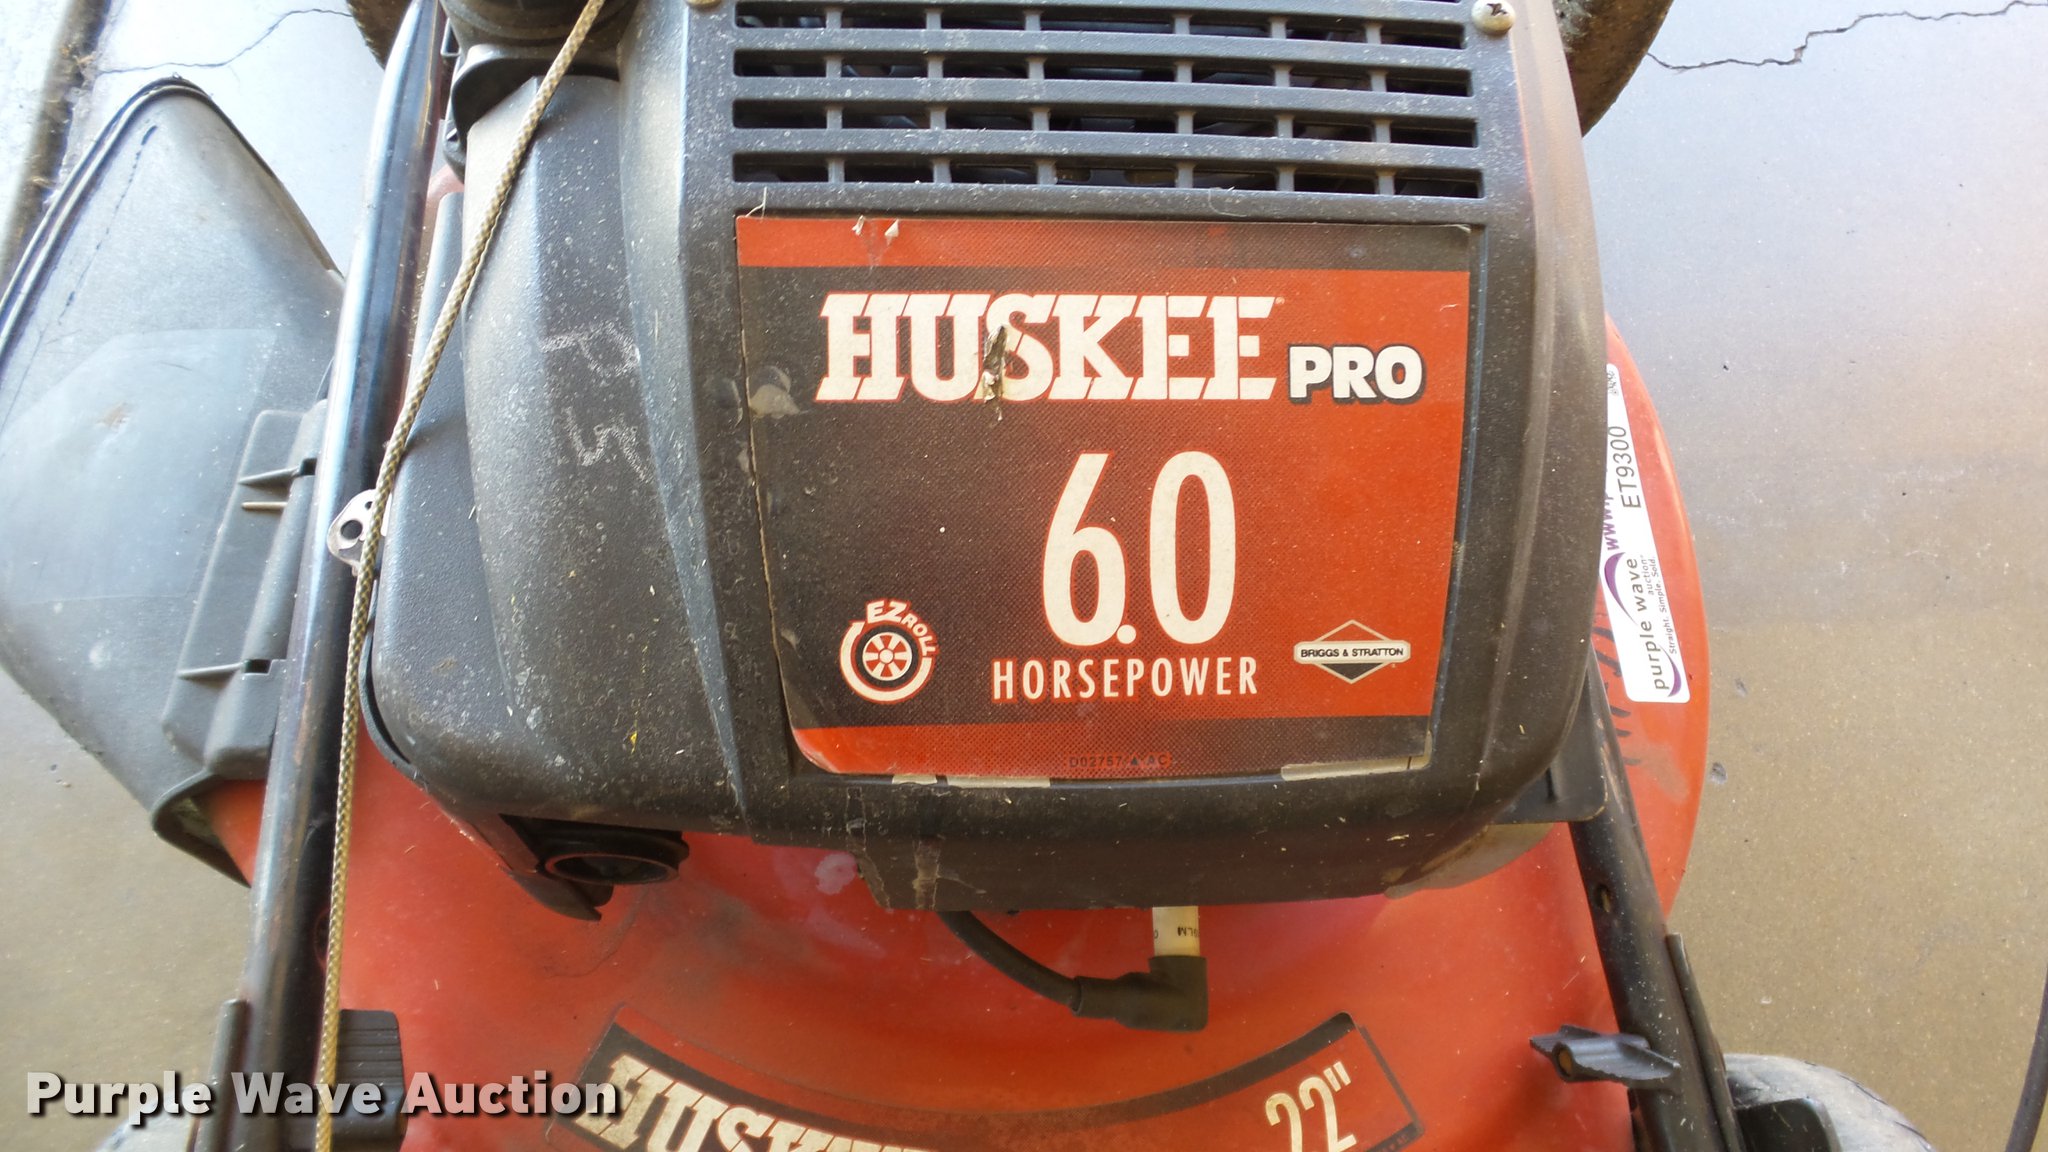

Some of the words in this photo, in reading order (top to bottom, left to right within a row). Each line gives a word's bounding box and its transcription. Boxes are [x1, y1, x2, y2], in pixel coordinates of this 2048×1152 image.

[815, 292, 1277, 401] HUSKEE
[1288, 344, 1425, 403] PRO
[1607, 426, 1642, 508] ET9300
[1043, 451, 1236, 646] 6.0
[1626, 558, 1648, 613] wave
[866, 600, 908, 624] EZ
[901, 613, 936, 656] ROLL
[1300, 649, 1340, 658] BRIGGS
[1342, 649, 1349, 657] &
[1351, 647, 1404, 657] STRATTON
[1639, 620, 1670, 691] purple
[992, 656, 1258, 700] HORSEPOWER
